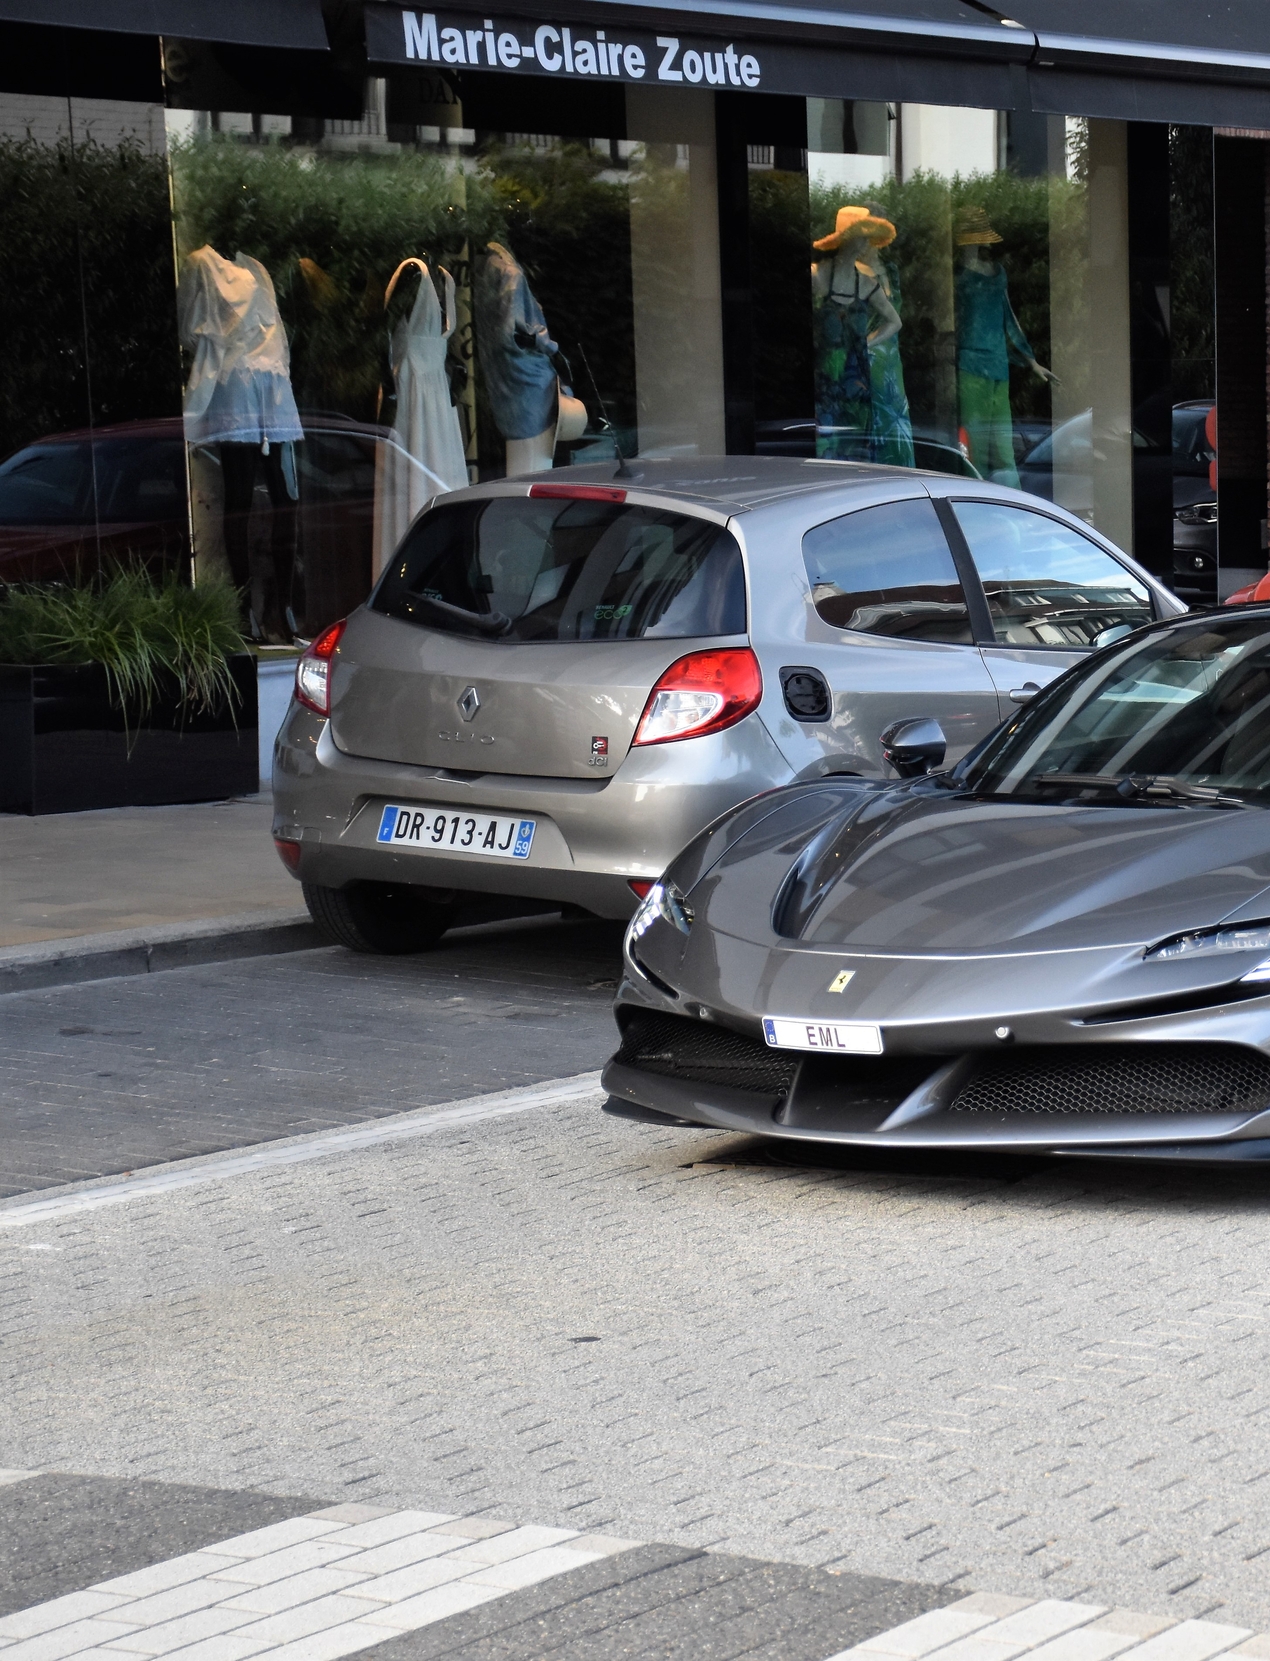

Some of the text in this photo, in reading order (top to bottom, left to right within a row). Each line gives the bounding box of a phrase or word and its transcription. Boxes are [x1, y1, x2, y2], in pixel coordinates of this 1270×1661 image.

[401, 11, 761, 87] Marie-Claire Zoute
[438, 730, 495, 745] CLIO
[382, 827, 389, 836] F
[394, 810, 516, 851] DR-913-AJ
[515, 840, 529, 854] 59
[769, 1034, 776, 1043] B
[805, 1025, 846, 1048] EML
